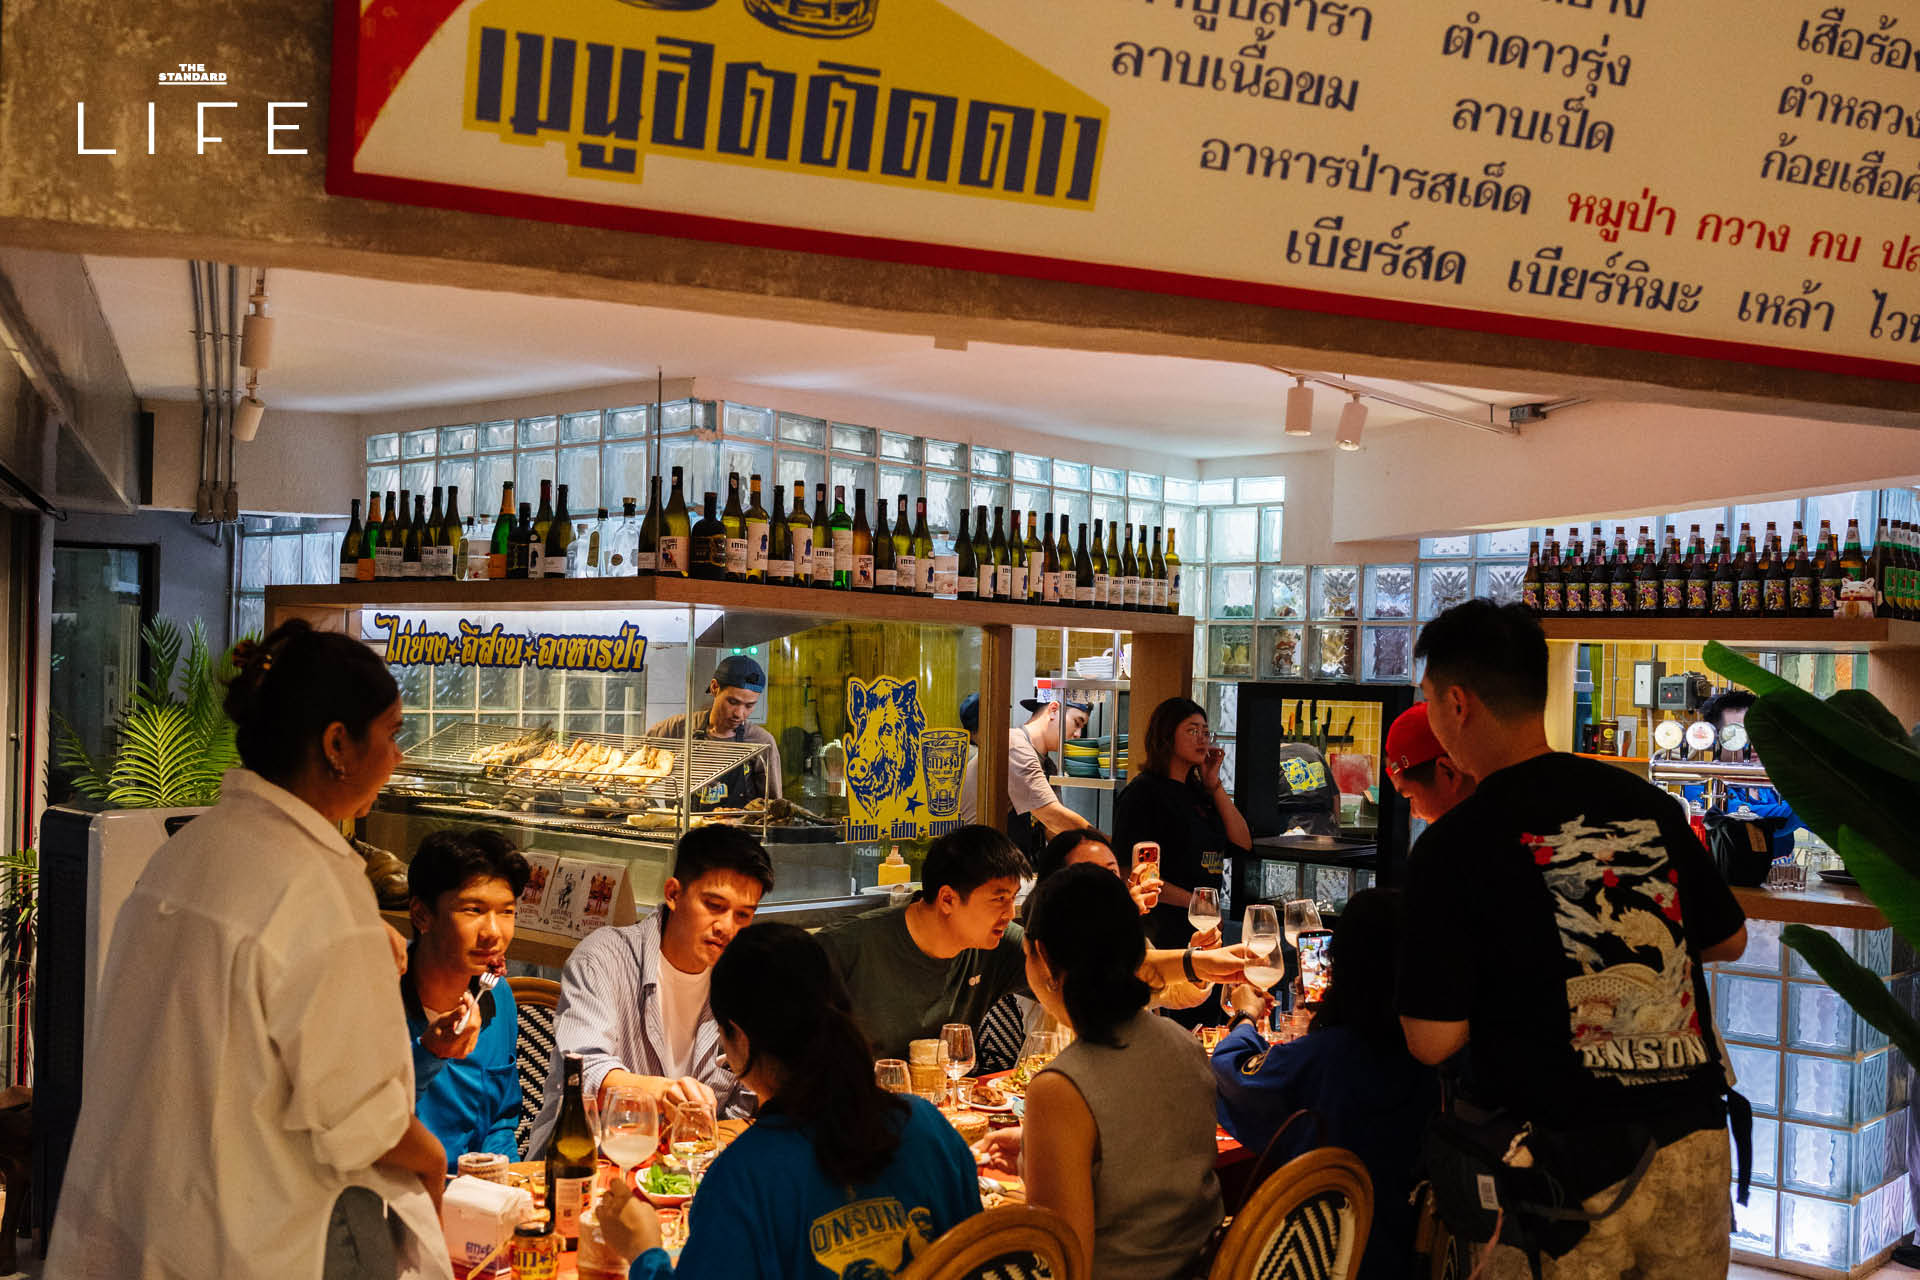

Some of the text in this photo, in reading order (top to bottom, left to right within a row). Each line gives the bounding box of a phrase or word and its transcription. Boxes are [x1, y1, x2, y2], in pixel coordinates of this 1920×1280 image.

[1111, 27, 1359, 112] ลาบเนื้อขม
[1441, 11, 1632, 98] ตำดาวรุ่ง
[1797, 6, 1920, 72] เสือร้อ
[475, 26, 1102, 202] เมนูฮิตติดดาว
[1452, 96, 1615, 154] ลาบเป็ด
[1200, 137, 1532, 215] อาหารป่ารสเด็ด
[1567, 187, 1677, 243] หมูป่า
[1696, 212, 1791, 253] กวาง
[1808, 229, 1862, 263] กบ
[1285, 216, 1467, 285] เบียร์สด
[1507, 246, 1704, 314] เบียร์หิมะ
[1737, 279, 1835, 332] เหล้า
[375, 613, 647, 671] ไก่ย่าง อีสาน อาหารป่า
[812, 1200, 908, 1255] ONSON
